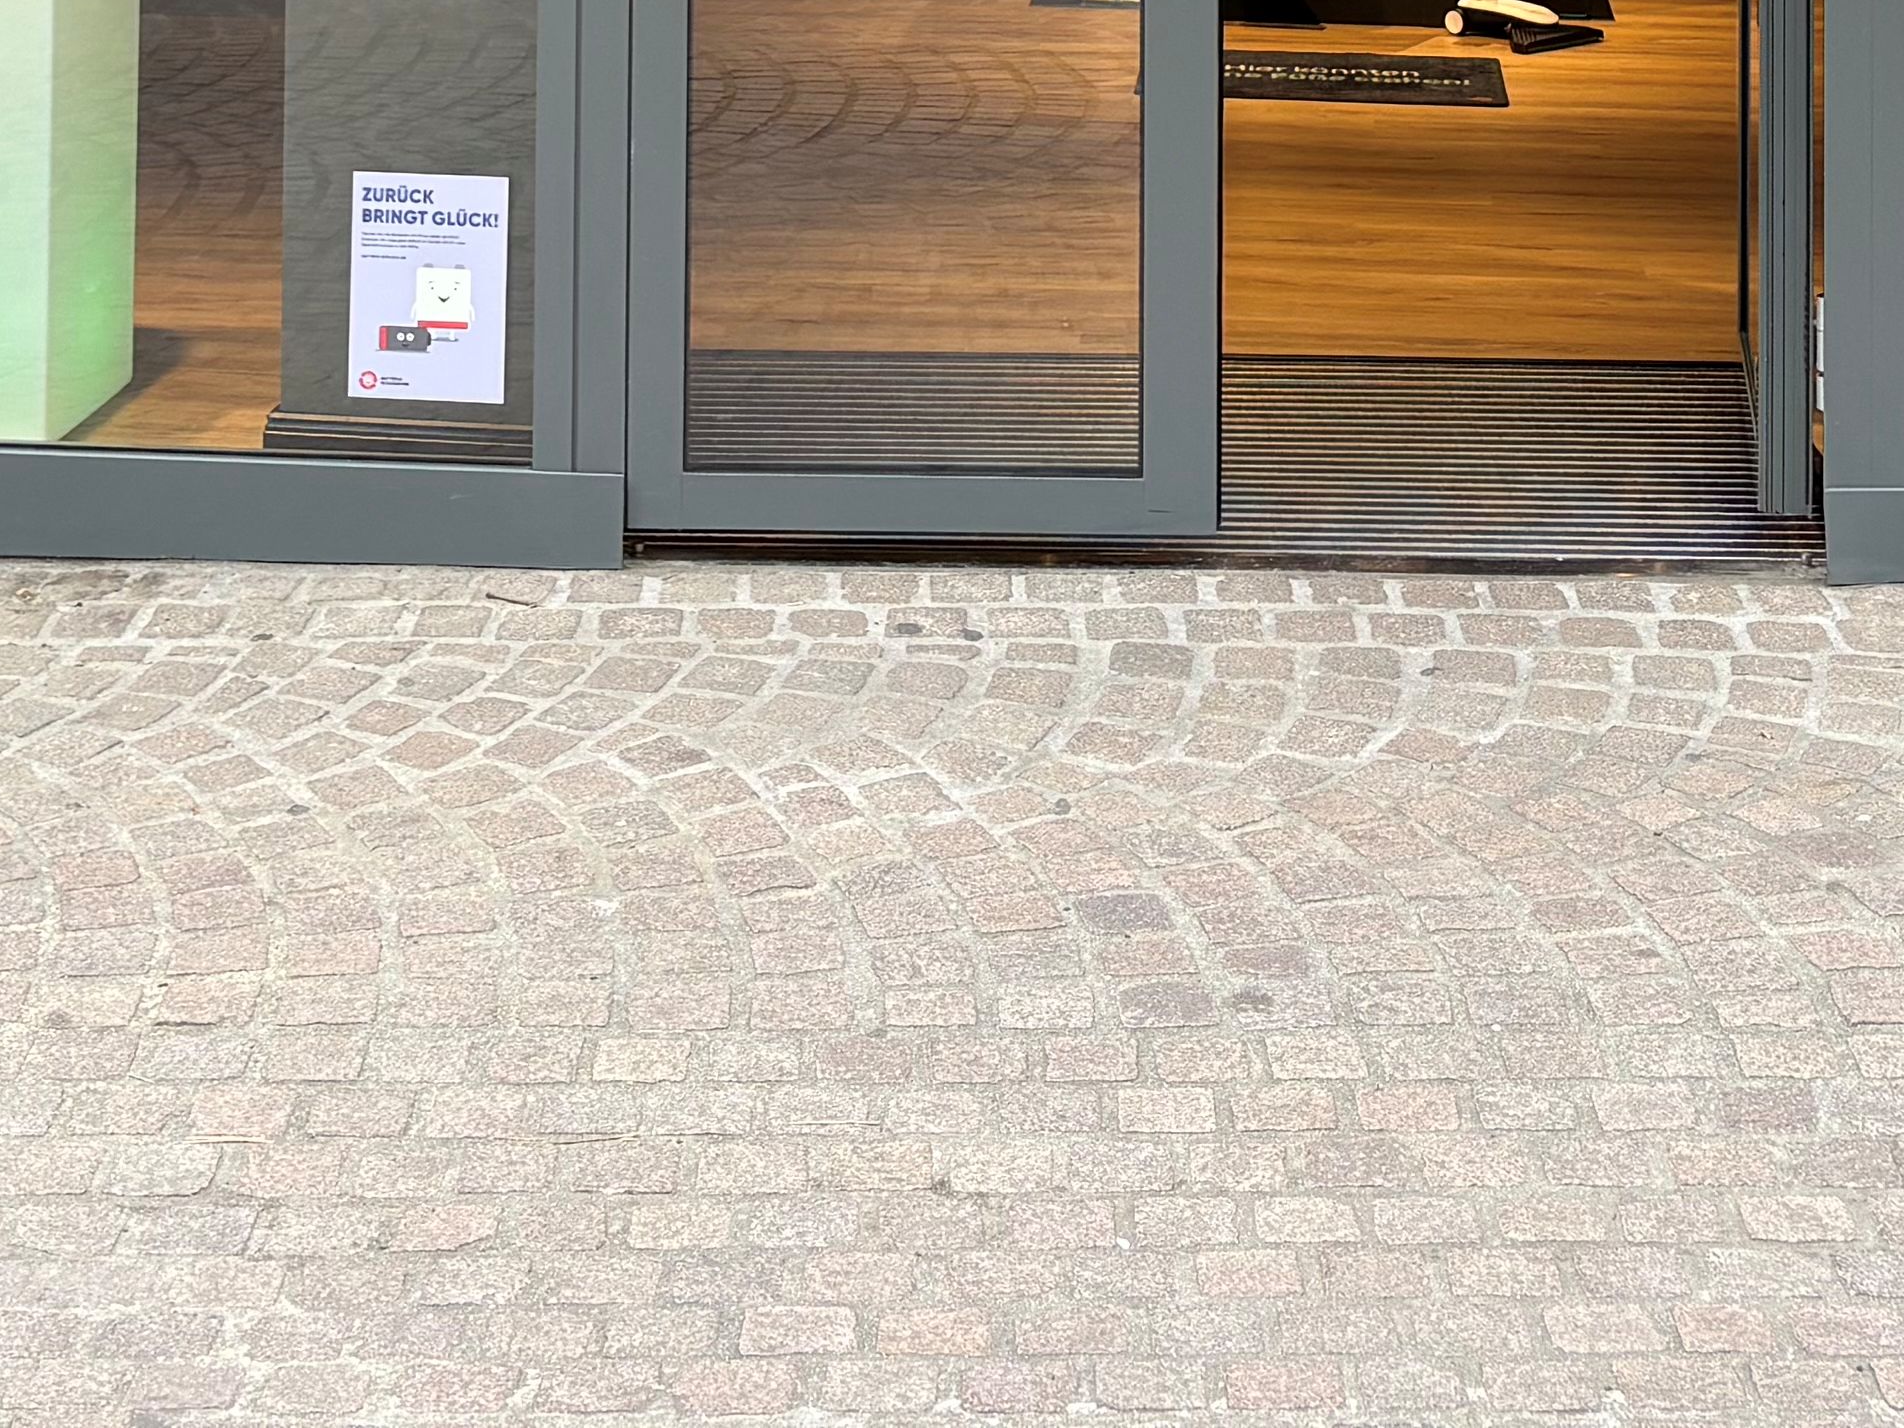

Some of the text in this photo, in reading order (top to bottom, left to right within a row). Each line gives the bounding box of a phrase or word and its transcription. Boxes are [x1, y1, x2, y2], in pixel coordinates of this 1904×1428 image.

[361, 184, 435, 205] ZURÜCK
[361, 208, 499, 228] BRINGT GLÜCK!
